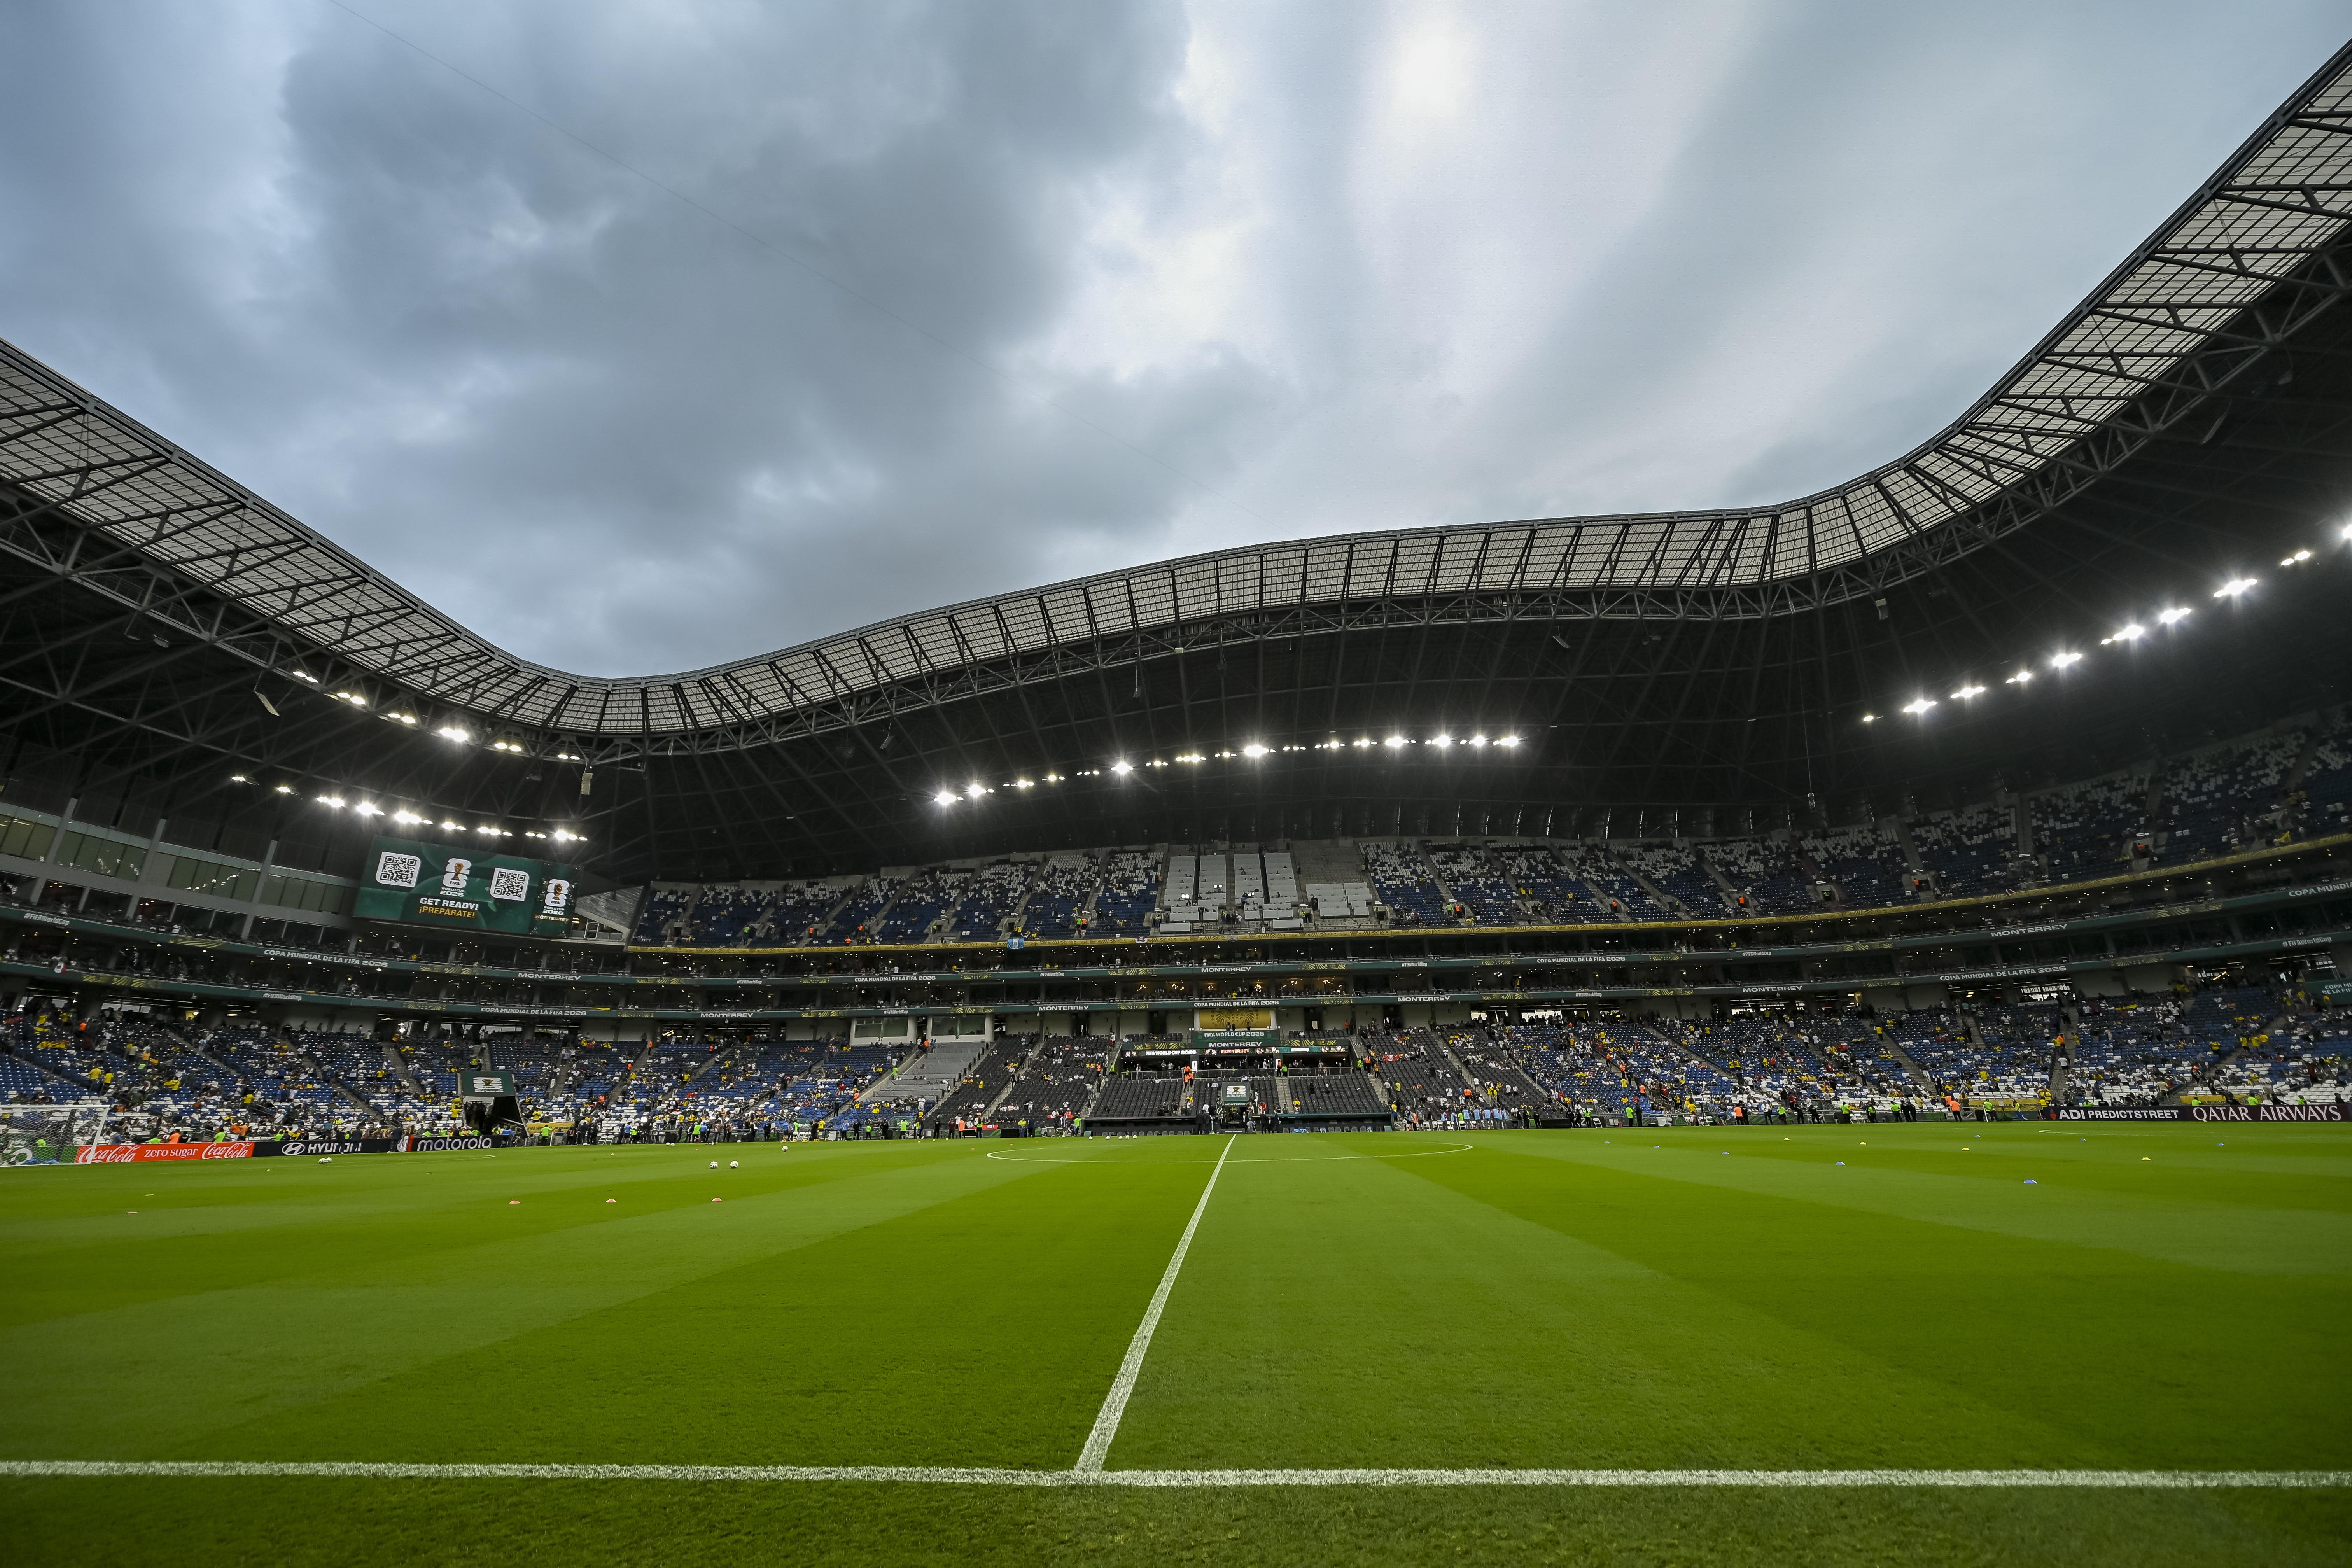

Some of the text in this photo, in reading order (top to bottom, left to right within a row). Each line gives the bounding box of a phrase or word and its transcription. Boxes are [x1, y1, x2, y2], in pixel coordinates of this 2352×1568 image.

[2289, 888, 2316, 897] COPA
[420, 897, 479, 910] GET READY!
[419, 906, 475, 918] ¡PREPÁRATE!
[24, 913, 70, 926] #FIFAWorldCup
[1991, 924, 2067, 937] MONTERREY
[2282, 937, 2332, 947] #FIFAWorldCup
[287, 952, 321, 961] MUNDIAL
[2059, 1109, 2179, 1120] ADI PREDICTSTREET
[2193, 1105, 2342, 1122] QATAR AIRWAYS
[417, 1136, 492, 1151] motorola
[78, 1145, 141, 1164] Cca-Cola
[144, 1148, 198, 1158] zero sugar
[201, 1142, 253, 1160] Coca-Cola
